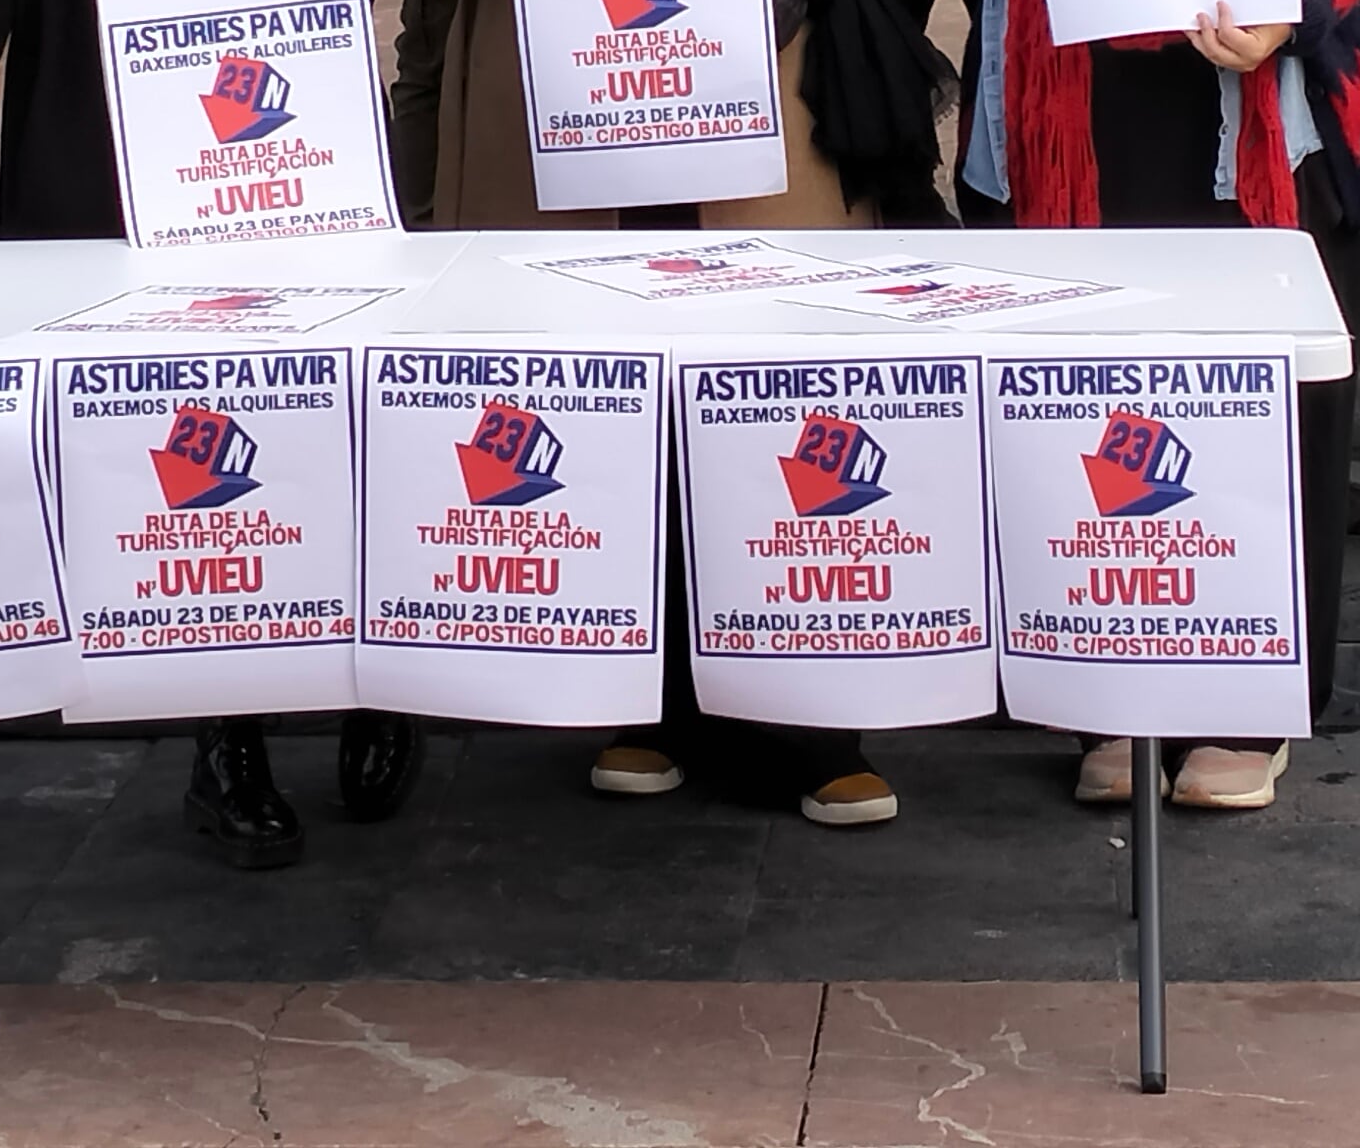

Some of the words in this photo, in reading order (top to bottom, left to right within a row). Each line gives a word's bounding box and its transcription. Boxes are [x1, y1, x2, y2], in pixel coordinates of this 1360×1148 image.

[124, 15, 245, 54] ASTURIES
[249, 11, 285, 38] PA
[288, 3, 353, 32] VIVIR
[549, 110, 619, 129] SÁBADU
[624, 109, 646, 124] 23
[650, 107, 673, 122] DE
[677, 100, 759, 120] PAYARES
[199, 145, 249, 165] RUTA
[253, 140, 278, 158] DE
[282, 137, 306, 154] LA
[67, 359, 208, 394] ASTURIES
[215, 358, 255, 388] PA
[261, 355, 336, 386] VIVIR
[377, 354, 518, 386] ASTURIES
[525, 356, 565, 388] PA
[573, 358, 646, 389] VIVIR
[695, 367, 837, 401] ASTURIES
[844, 366, 885, 396] PA
[890, 364, 966, 395] VIVIR
[998, 364, 1142, 396] ASTURIES
[1149, 363, 1190, 394] PA
[1196, 363, 1273, 393] VIVIR
[381, 390, 475, 408] BAXEMOS
[524, 394, 642, 413] ALQUILERES
[774, 520, 832, 538] RUTA
[837, 519, 866, 537] DE
[871, 519, 899, 536] LA
[83, 606, 170, 629] SÁBADU
[177, 606, 203, 624] 23
[209, 604, 237, 623] DE
[243, 598, 343, 621] PAYARES
[1010, 631, 1058, 651] 17:00
[1072, 636, 1193, 656] C/POSTIGO
[1200, 637, 1255, 656] BAJO
[1262, 637, 1289, 656] 46
